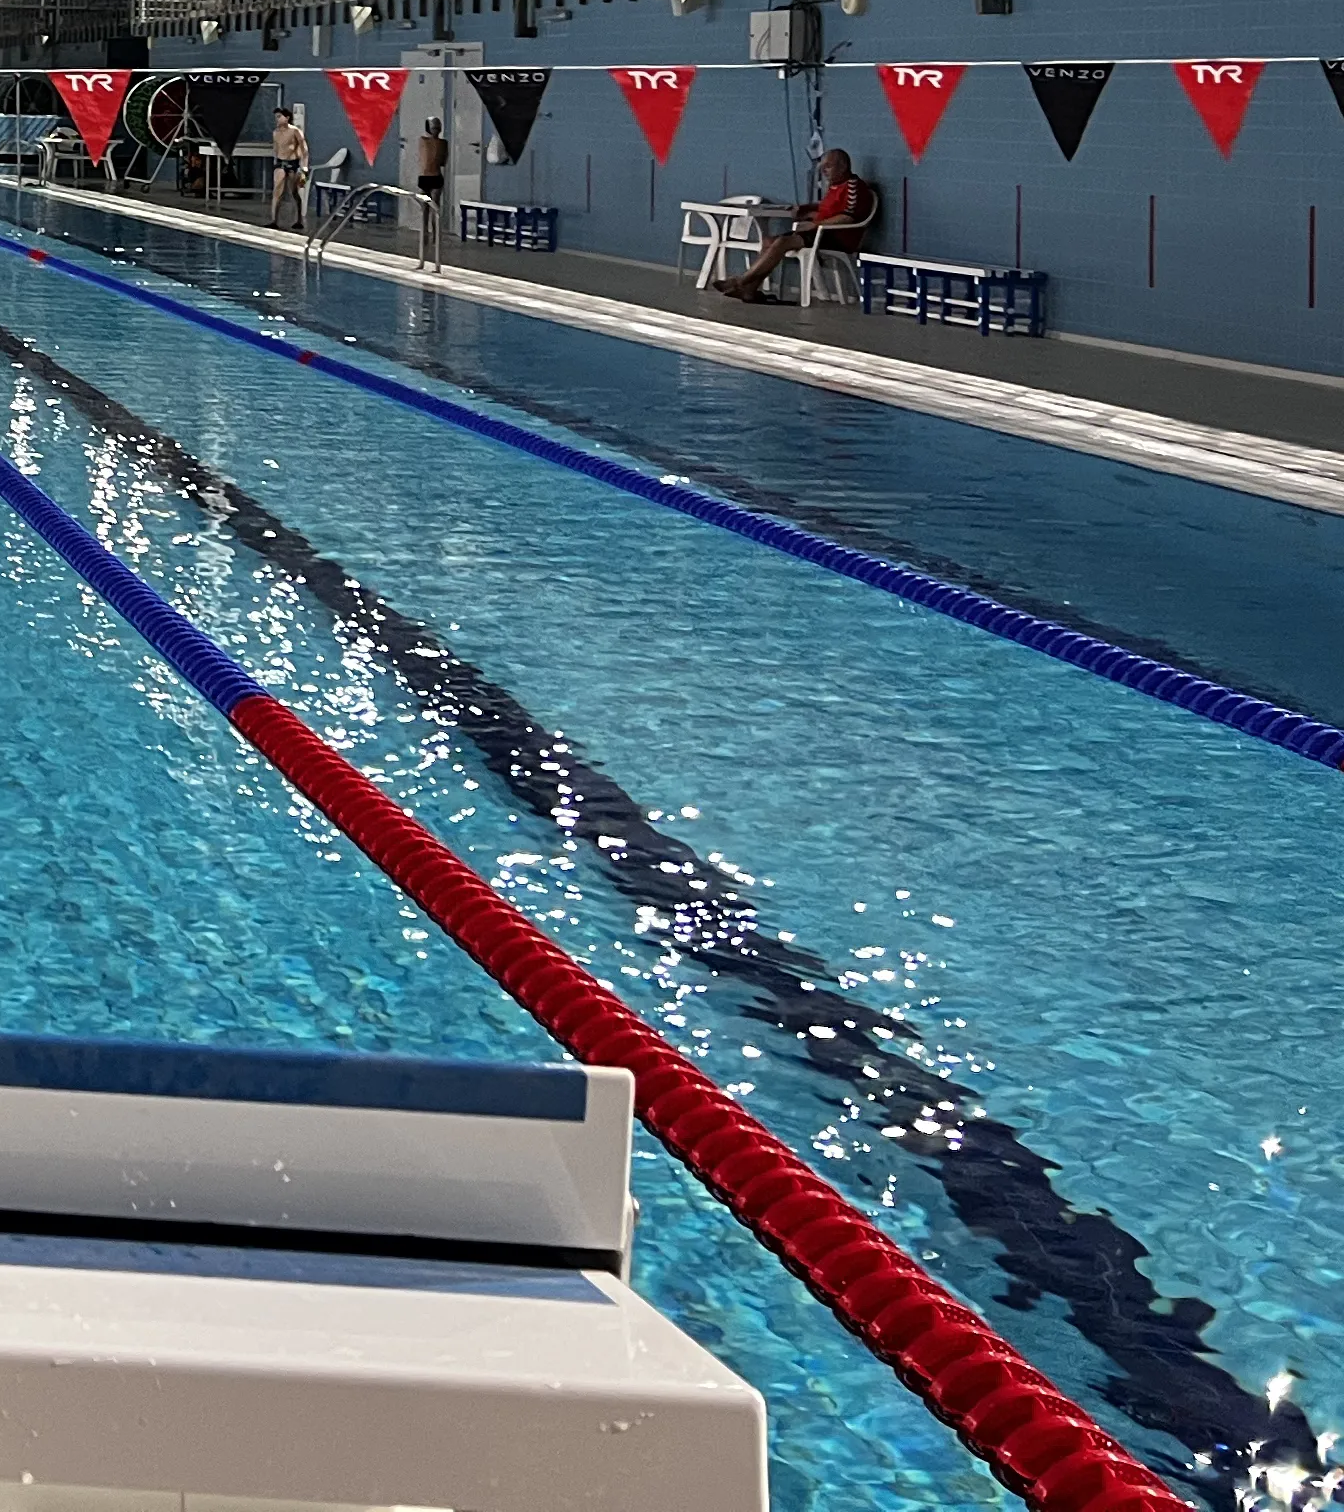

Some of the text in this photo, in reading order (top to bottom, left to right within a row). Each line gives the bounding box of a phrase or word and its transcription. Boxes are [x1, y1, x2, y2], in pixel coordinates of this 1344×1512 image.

[65, 74, 114, 92] TYR
[341, 72, 391, 90] TYR
[627, 71, 679, 89] TYR
[893, 68, 943, 88] TYR
[1192, 65, 1243, 83] TYR
